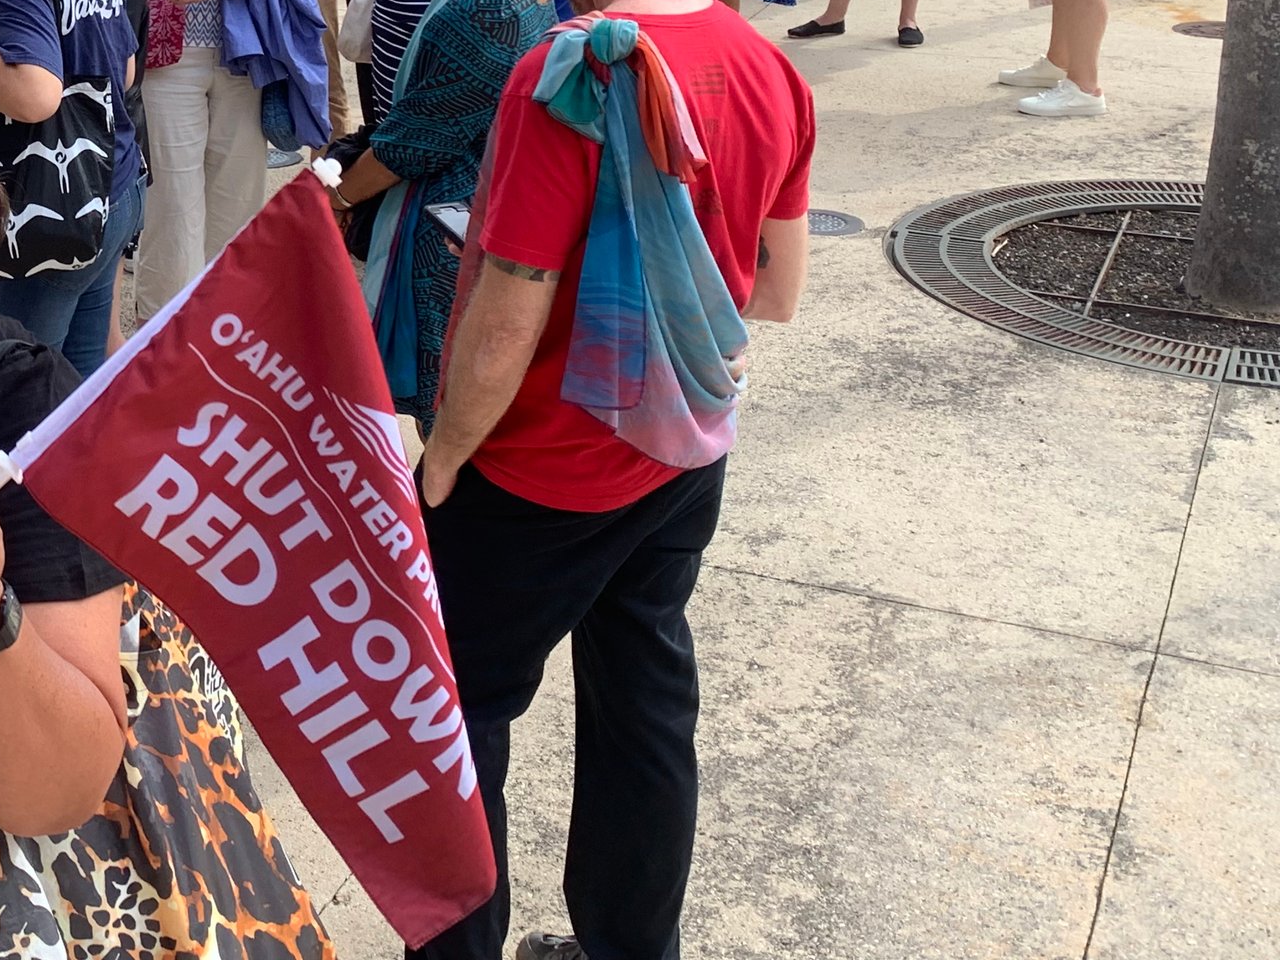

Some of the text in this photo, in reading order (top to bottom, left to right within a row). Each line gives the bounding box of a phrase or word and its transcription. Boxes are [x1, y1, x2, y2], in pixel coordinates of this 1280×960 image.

[113, 452, 431, 845] RED HILL
[176, 401, 478, 801] SHUT DOWN
[309, 413, 414, 562] WATER
